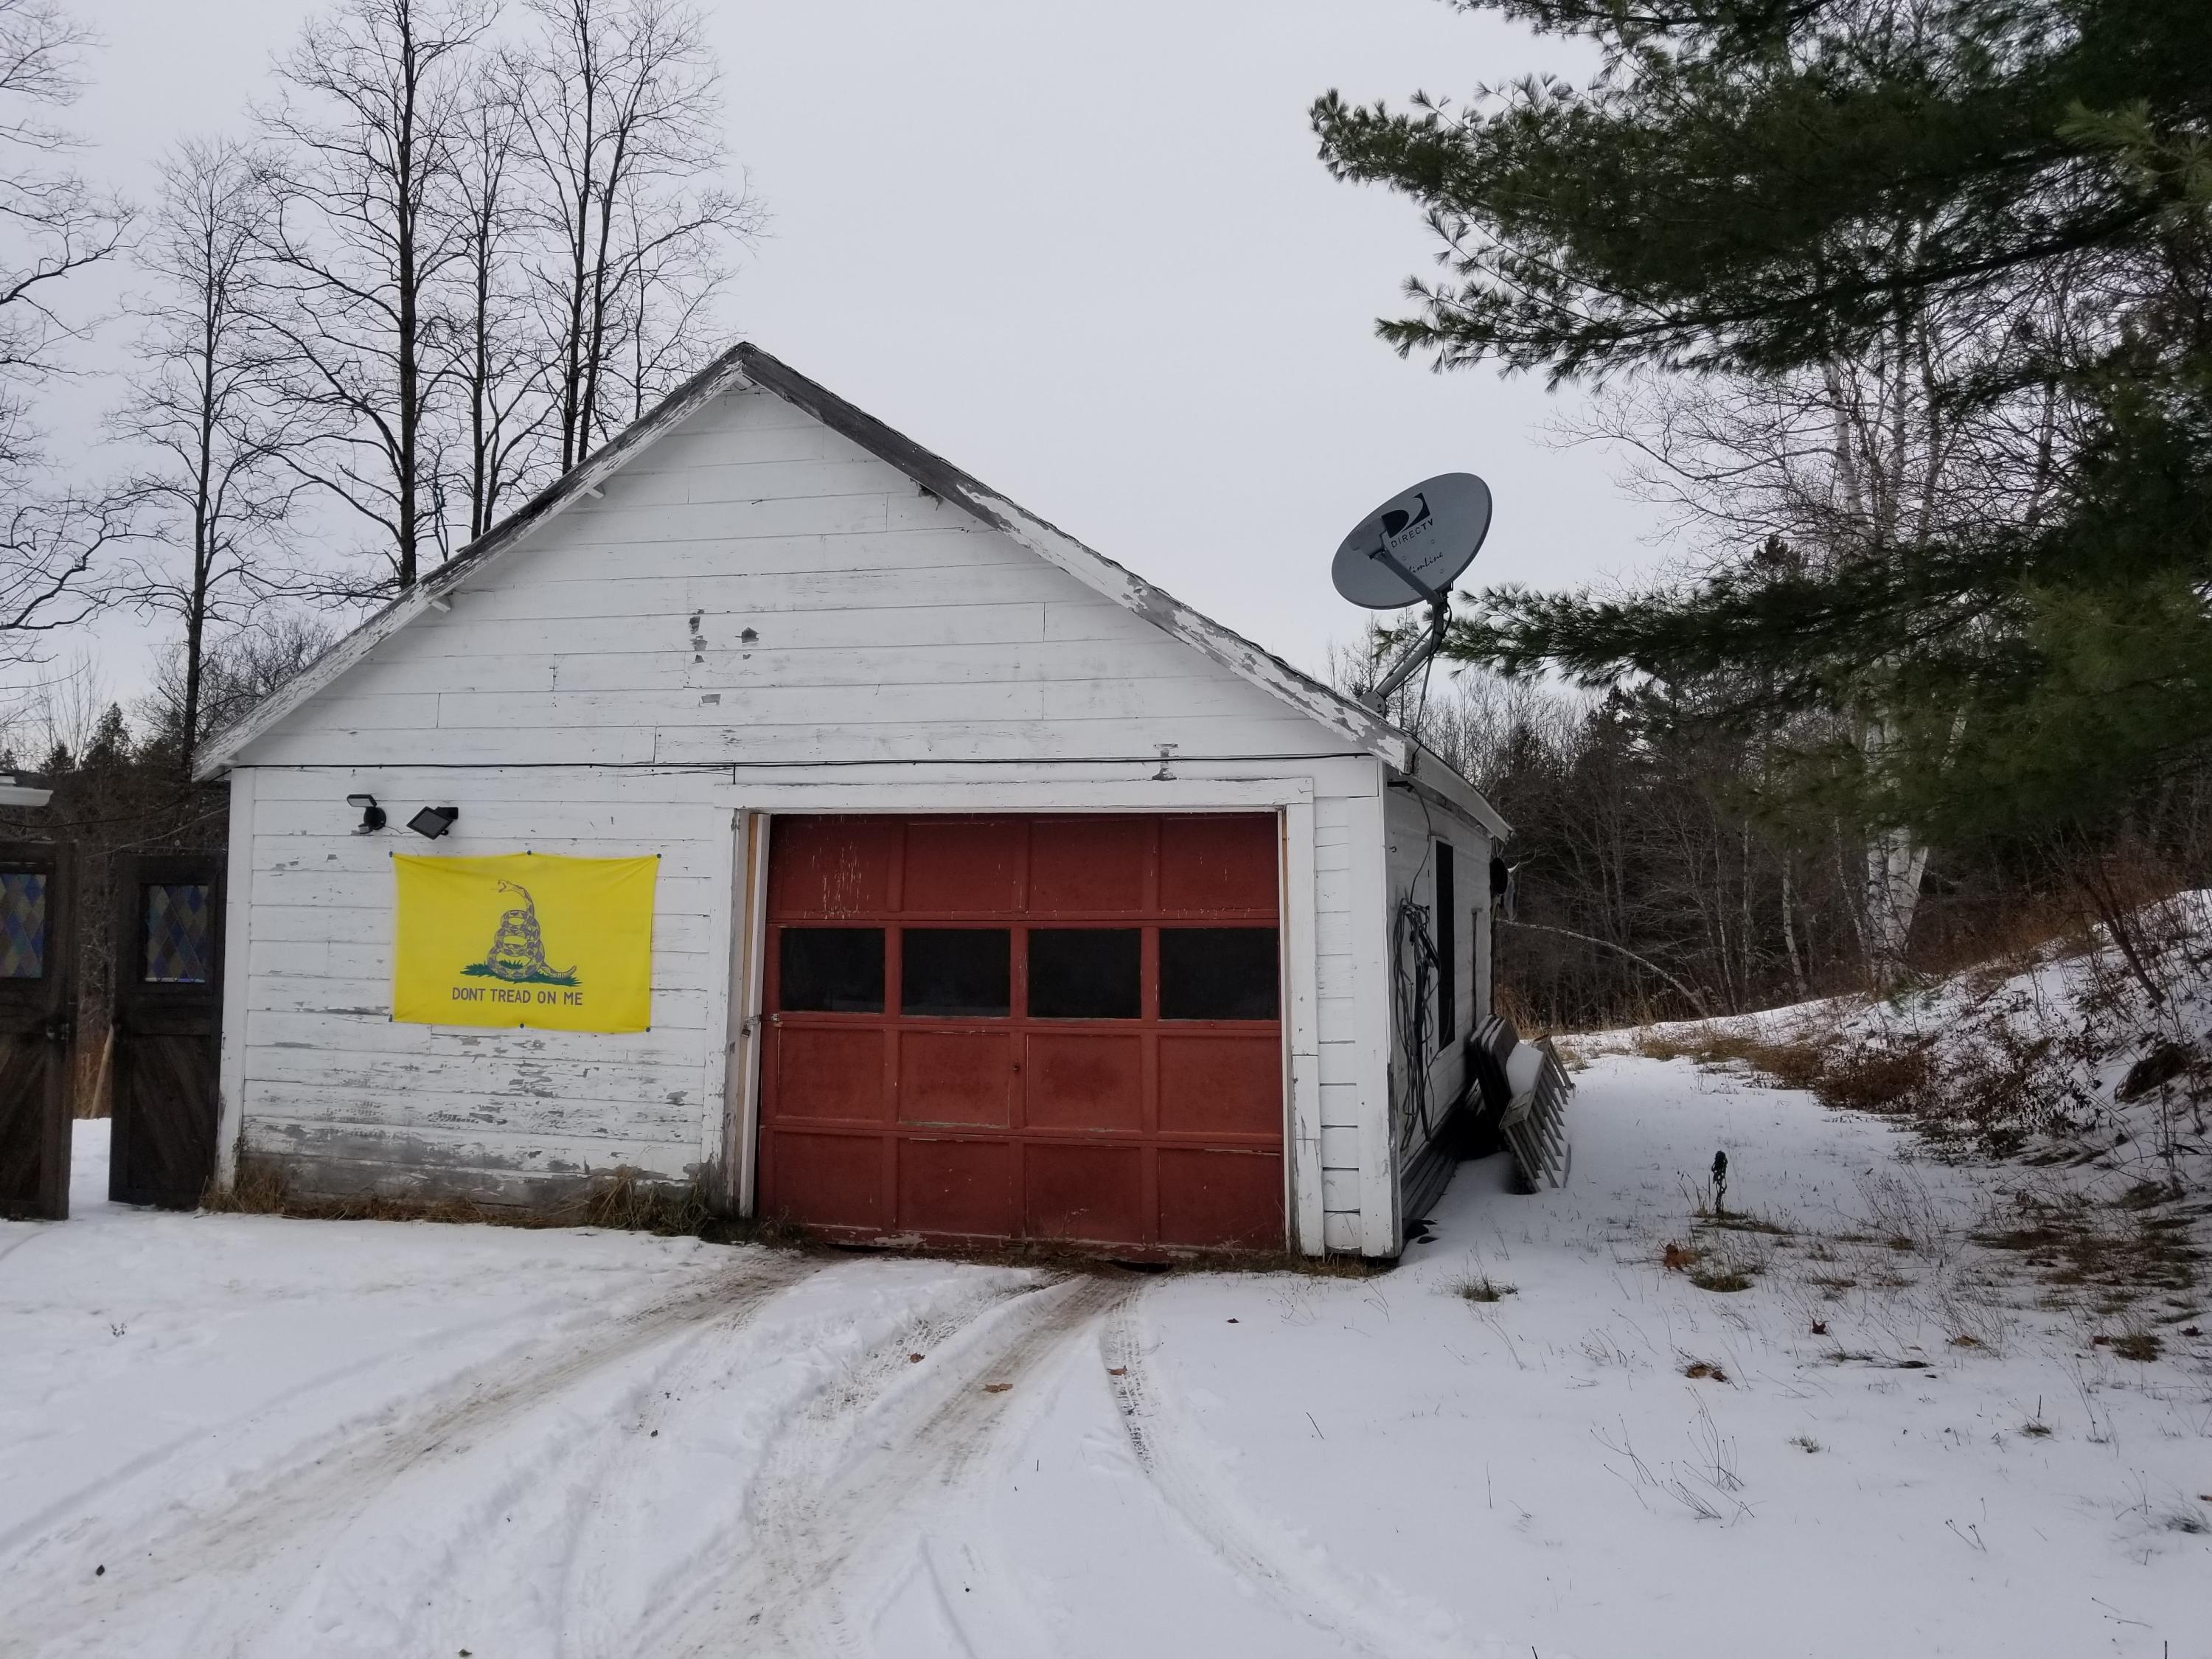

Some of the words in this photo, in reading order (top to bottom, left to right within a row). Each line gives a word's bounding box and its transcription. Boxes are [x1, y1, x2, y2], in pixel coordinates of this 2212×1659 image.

[1390, 518, 1434, 548] DIRECTV
[452, 987, 486, 1001] DONT
[490, 988, 531, 1003] TREAD
[537, 990, 556, 1004] ON
[563, 991, 583, 1006] ME
